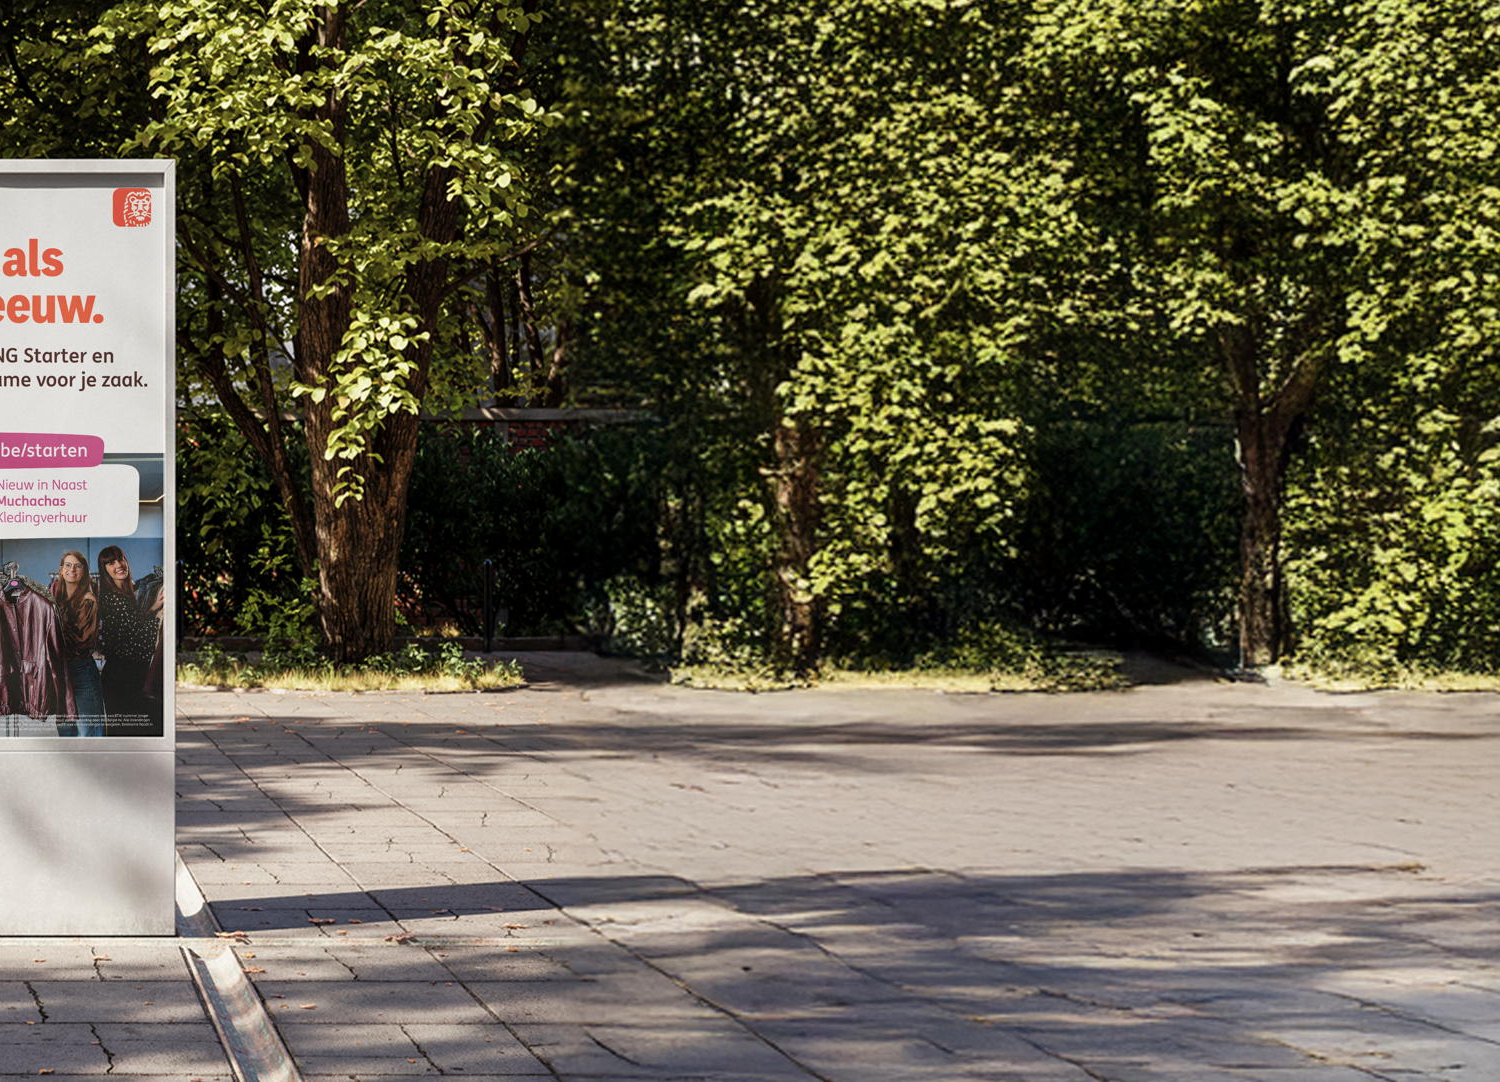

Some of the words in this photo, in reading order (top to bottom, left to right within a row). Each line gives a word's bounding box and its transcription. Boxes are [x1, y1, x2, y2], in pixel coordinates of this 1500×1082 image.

[2, 238, 64, 277] als
[23, 347, 87, 364] Starter
[92, 352, 114, 364] en
[36, 375, 76, 387] voor
[79, 371, 97, 391] je
[102, 371, 148, 387] zaak.
[38, 479, 49, 490] in
[52, 479, 88, 491] Naast
